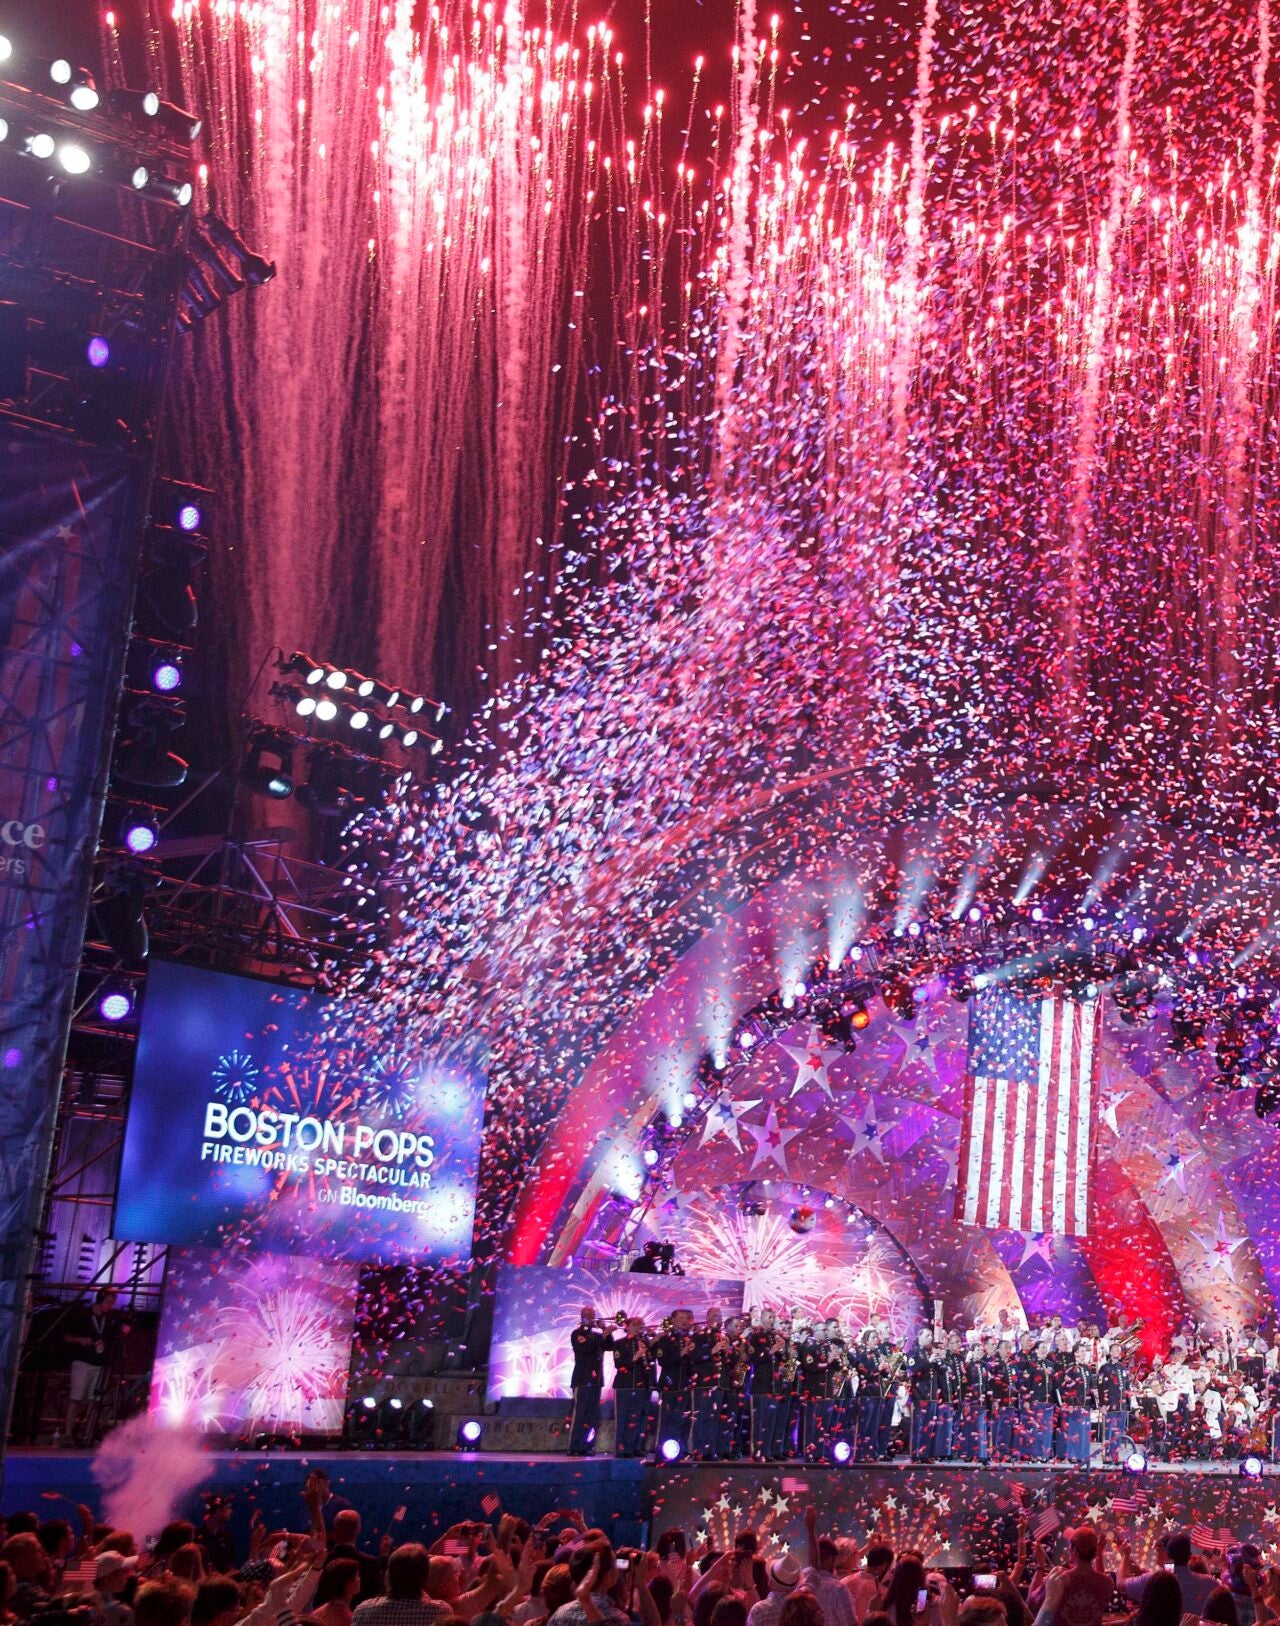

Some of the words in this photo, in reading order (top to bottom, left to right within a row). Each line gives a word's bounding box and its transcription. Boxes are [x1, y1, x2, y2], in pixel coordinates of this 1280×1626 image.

[1, 820, 45, 849] ce
[203, 1102, 345, 1155] BOSTON
[353, 1125, 435, 1168] POPS
[201, 1142, 309, 1173] FIREWORKS
[314, 1157, 432, 1189] SPECTACULAR
[340, 1186, 430, 1220] Bloomberg
